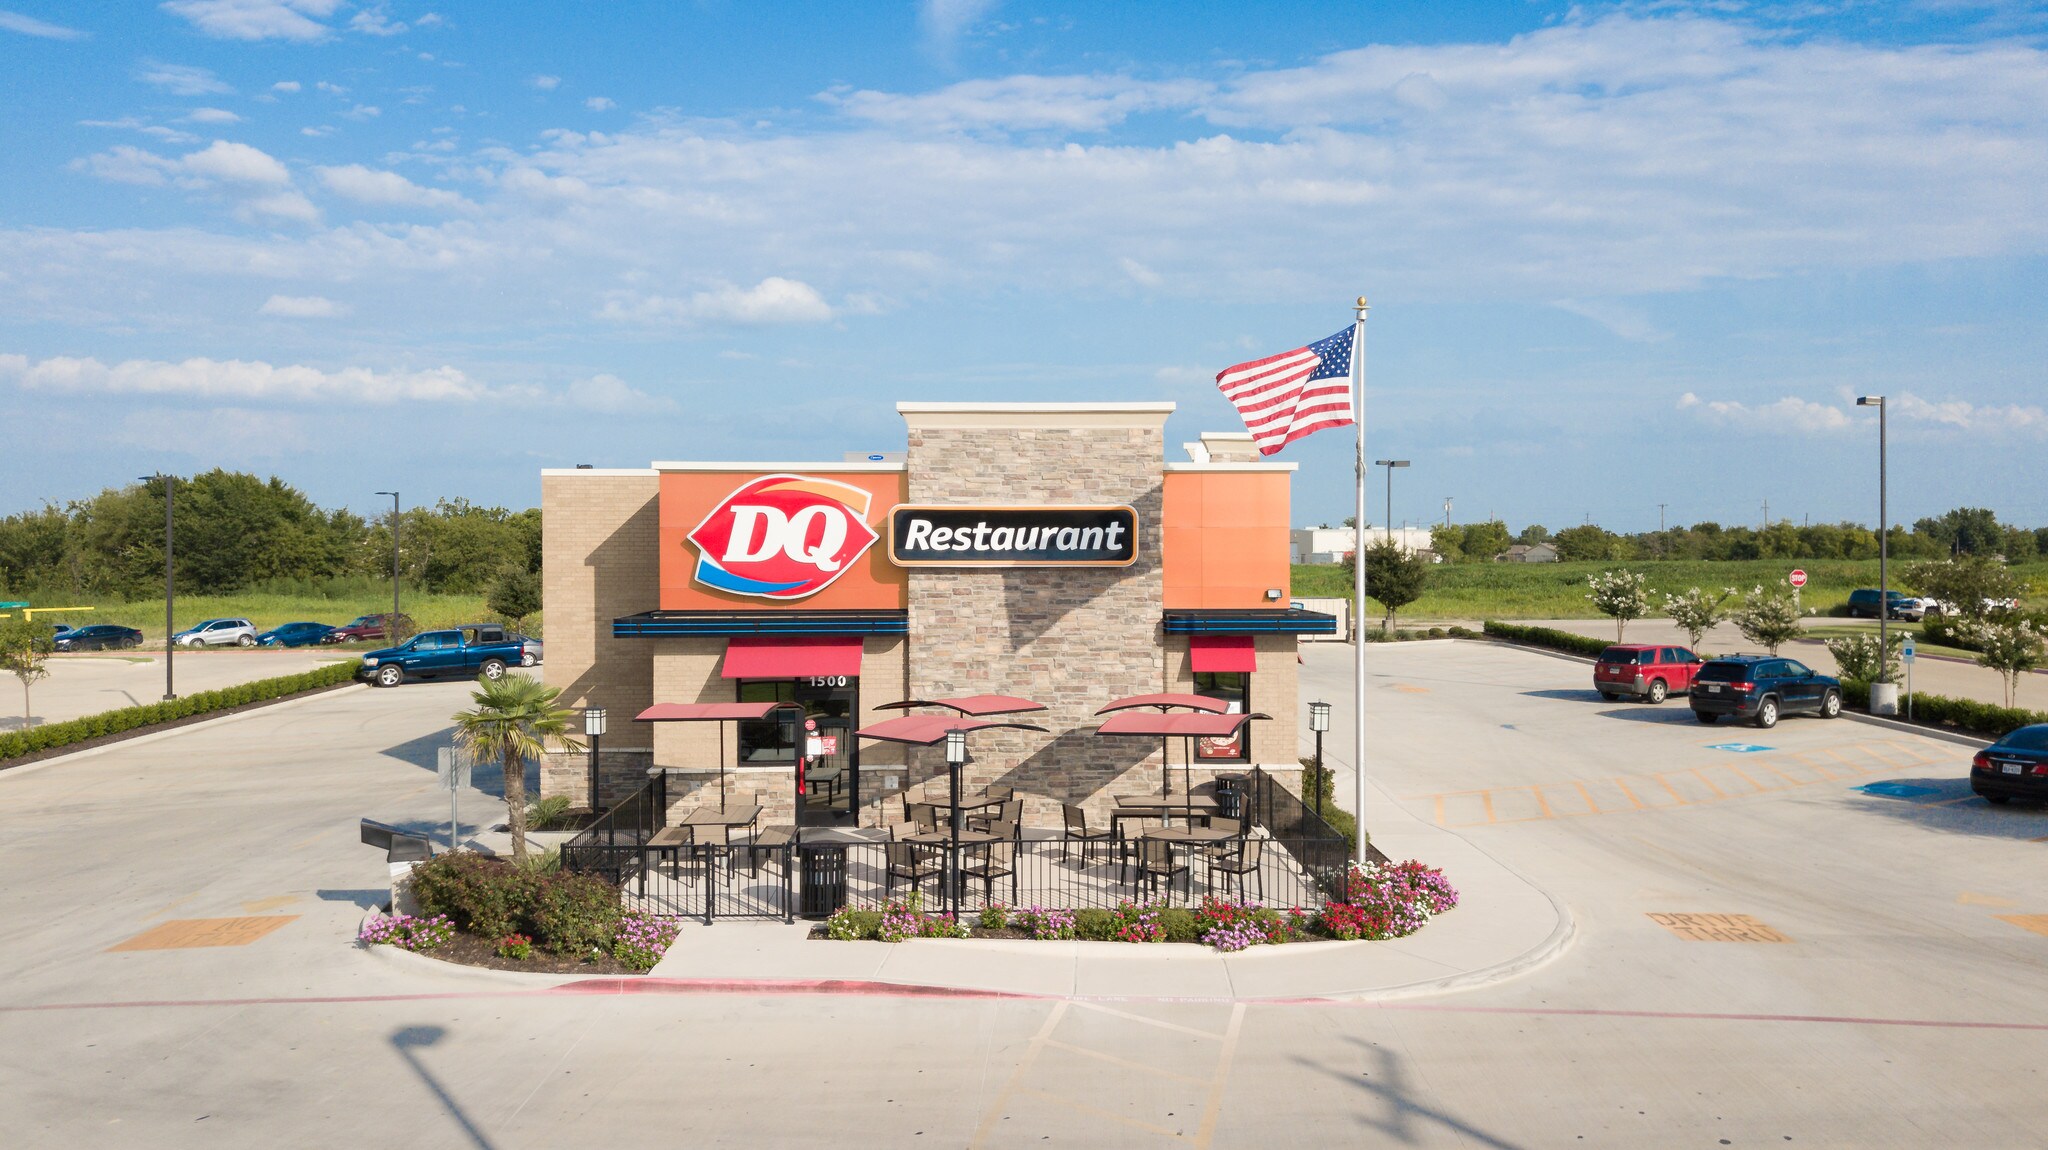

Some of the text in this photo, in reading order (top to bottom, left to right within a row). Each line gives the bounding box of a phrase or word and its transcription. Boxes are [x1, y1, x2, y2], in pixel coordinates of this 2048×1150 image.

[722, 505, 847, 572] DQ
[905, 519, 1125, 551] Restaurant
[1791, 574, 1806, 582] STOP
[810, 676, 847, 687] 1500
[1645, 912, 1768, 927] DRIVE
[1673, 927, 1784, 942] THRU
